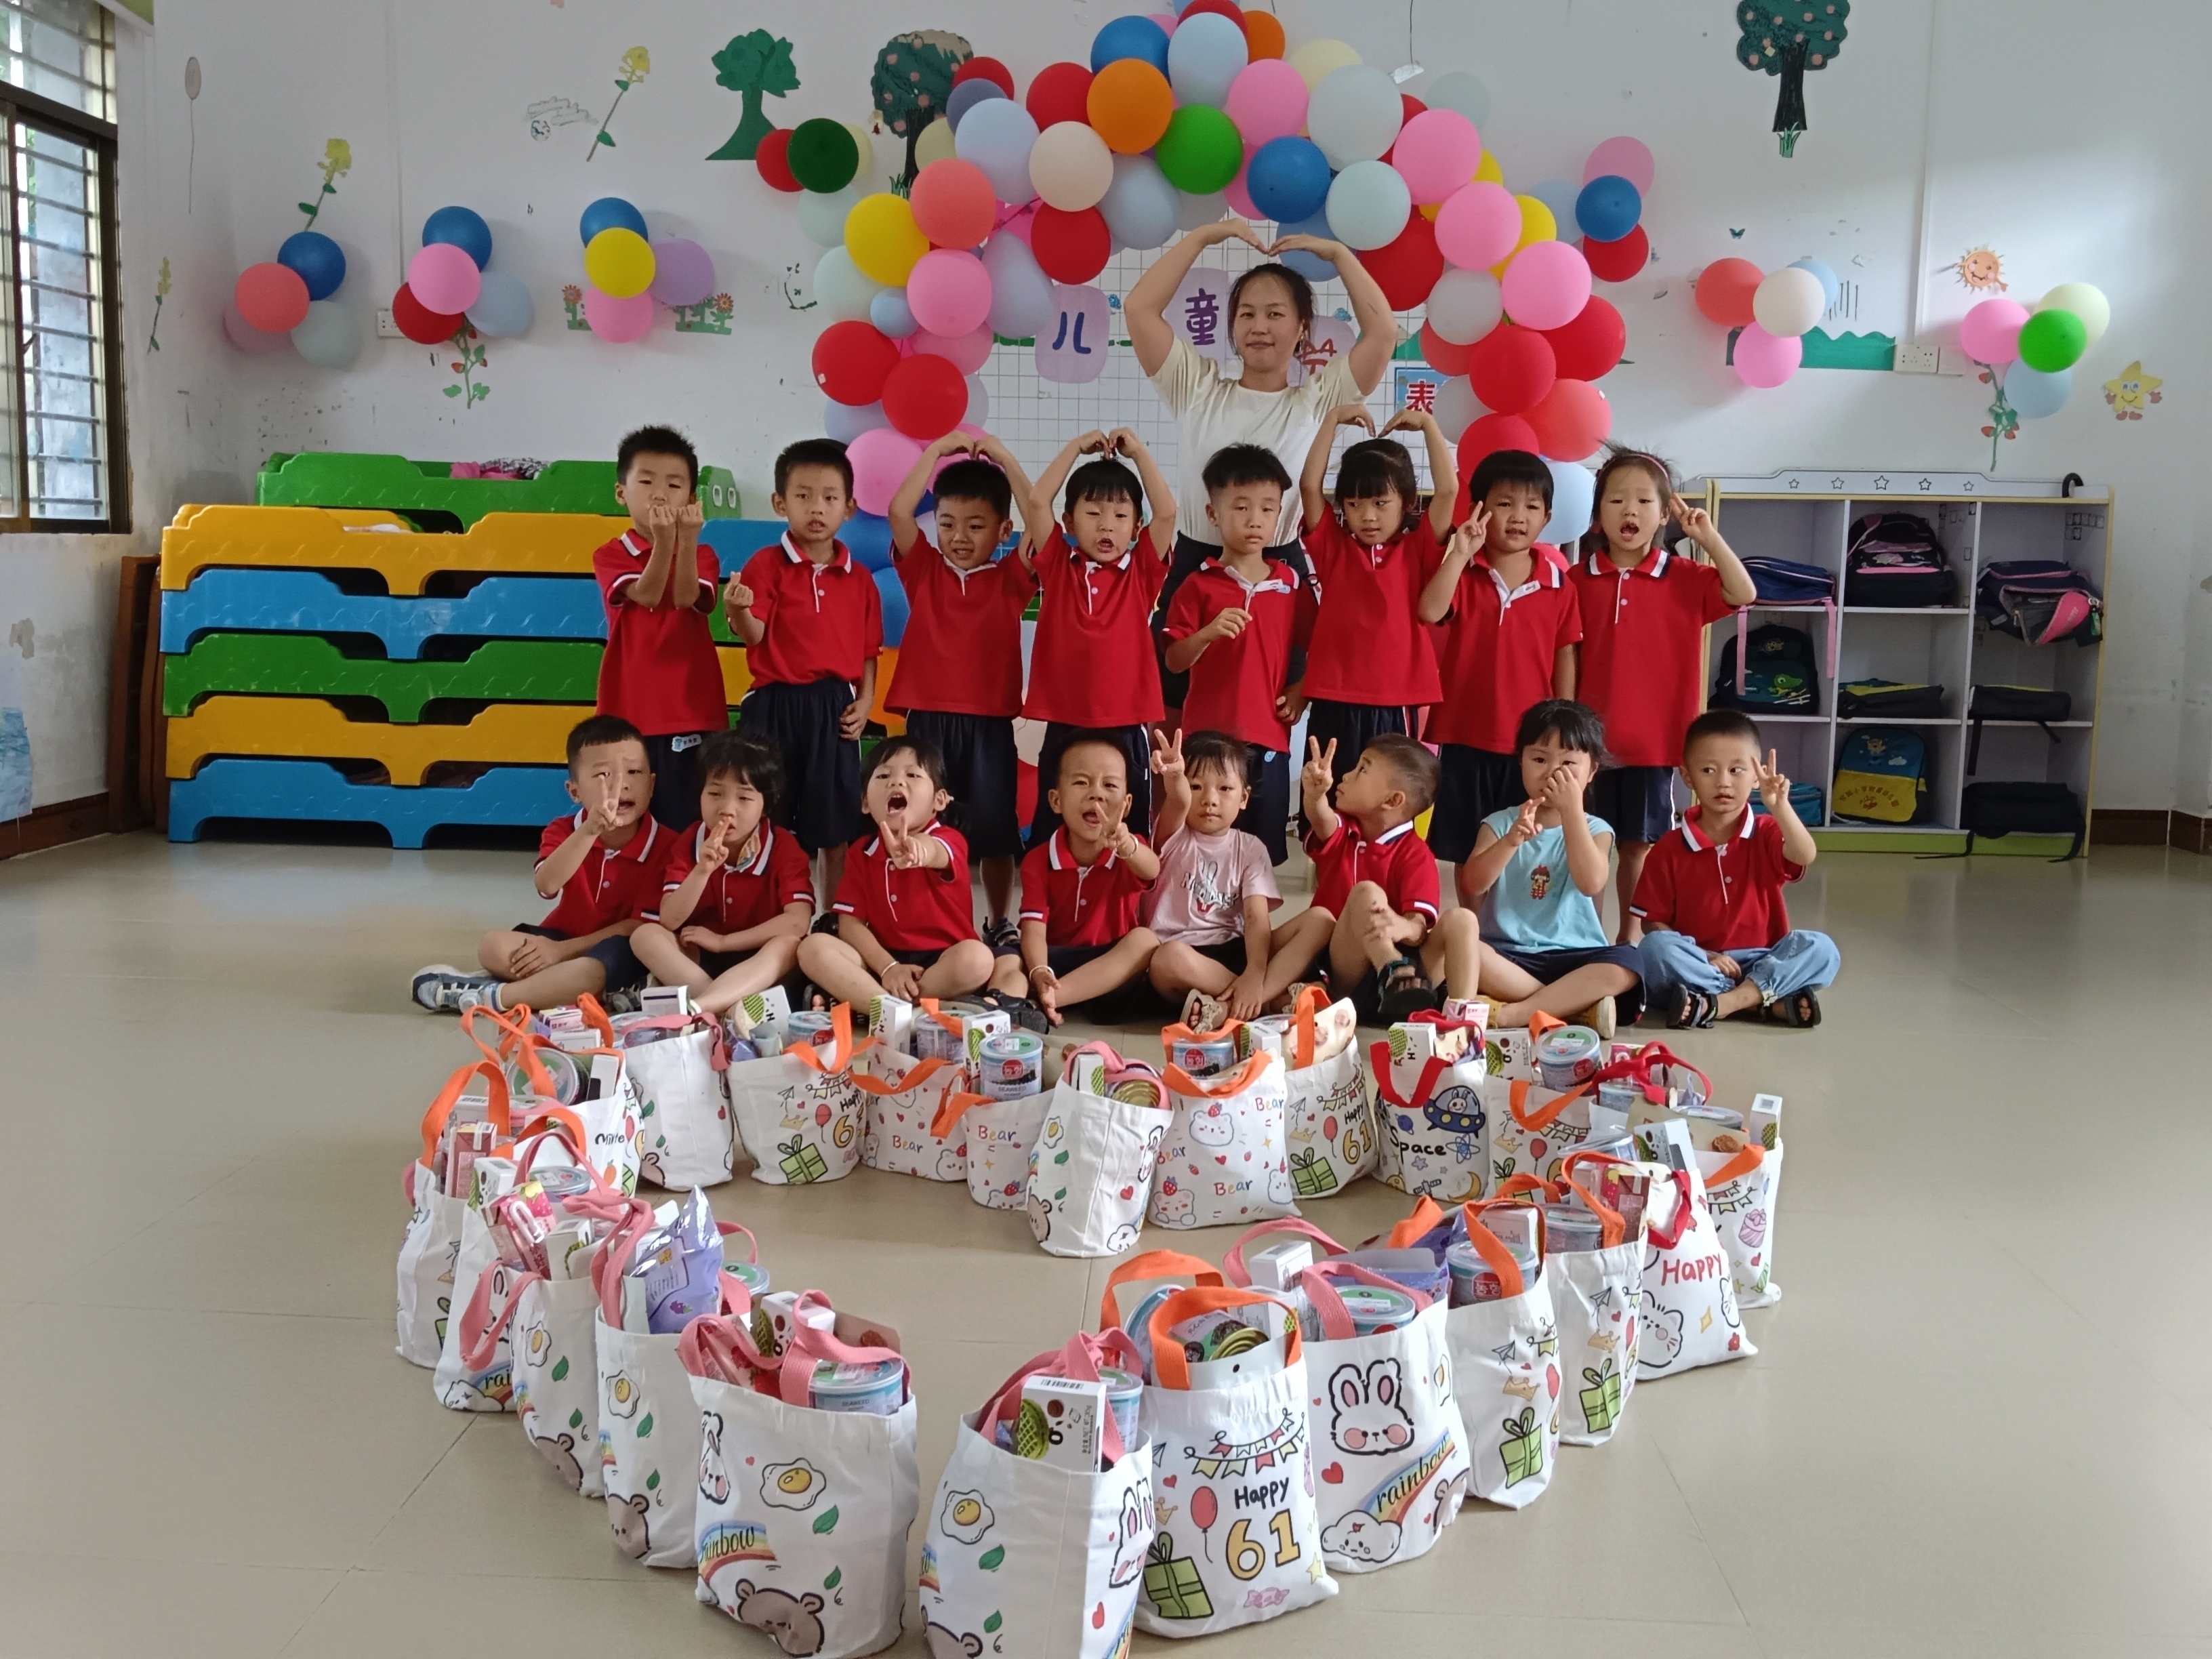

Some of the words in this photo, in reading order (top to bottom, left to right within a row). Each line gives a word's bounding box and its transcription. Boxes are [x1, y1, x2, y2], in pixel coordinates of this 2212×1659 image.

[1052, 311, 1092, 354] 儿
[1185, 288, 1219, 346] 童
[1255, 1097, 1284, 1111] Bear
[1344, 1101, 1364, 1125] Happy
[892, 1135, 923, 1154] Bear
[978, 1125, 1017, 1143] Bear
[1343, 1120, 1372, 1165] 61
[1389, 1125, 1447, 1165] Space
[1213, 1179, 1253, 1196] Bear
[1233, 1477, 1290, 1510] Happy
[1225, 1509, 1301, 1581] 61
